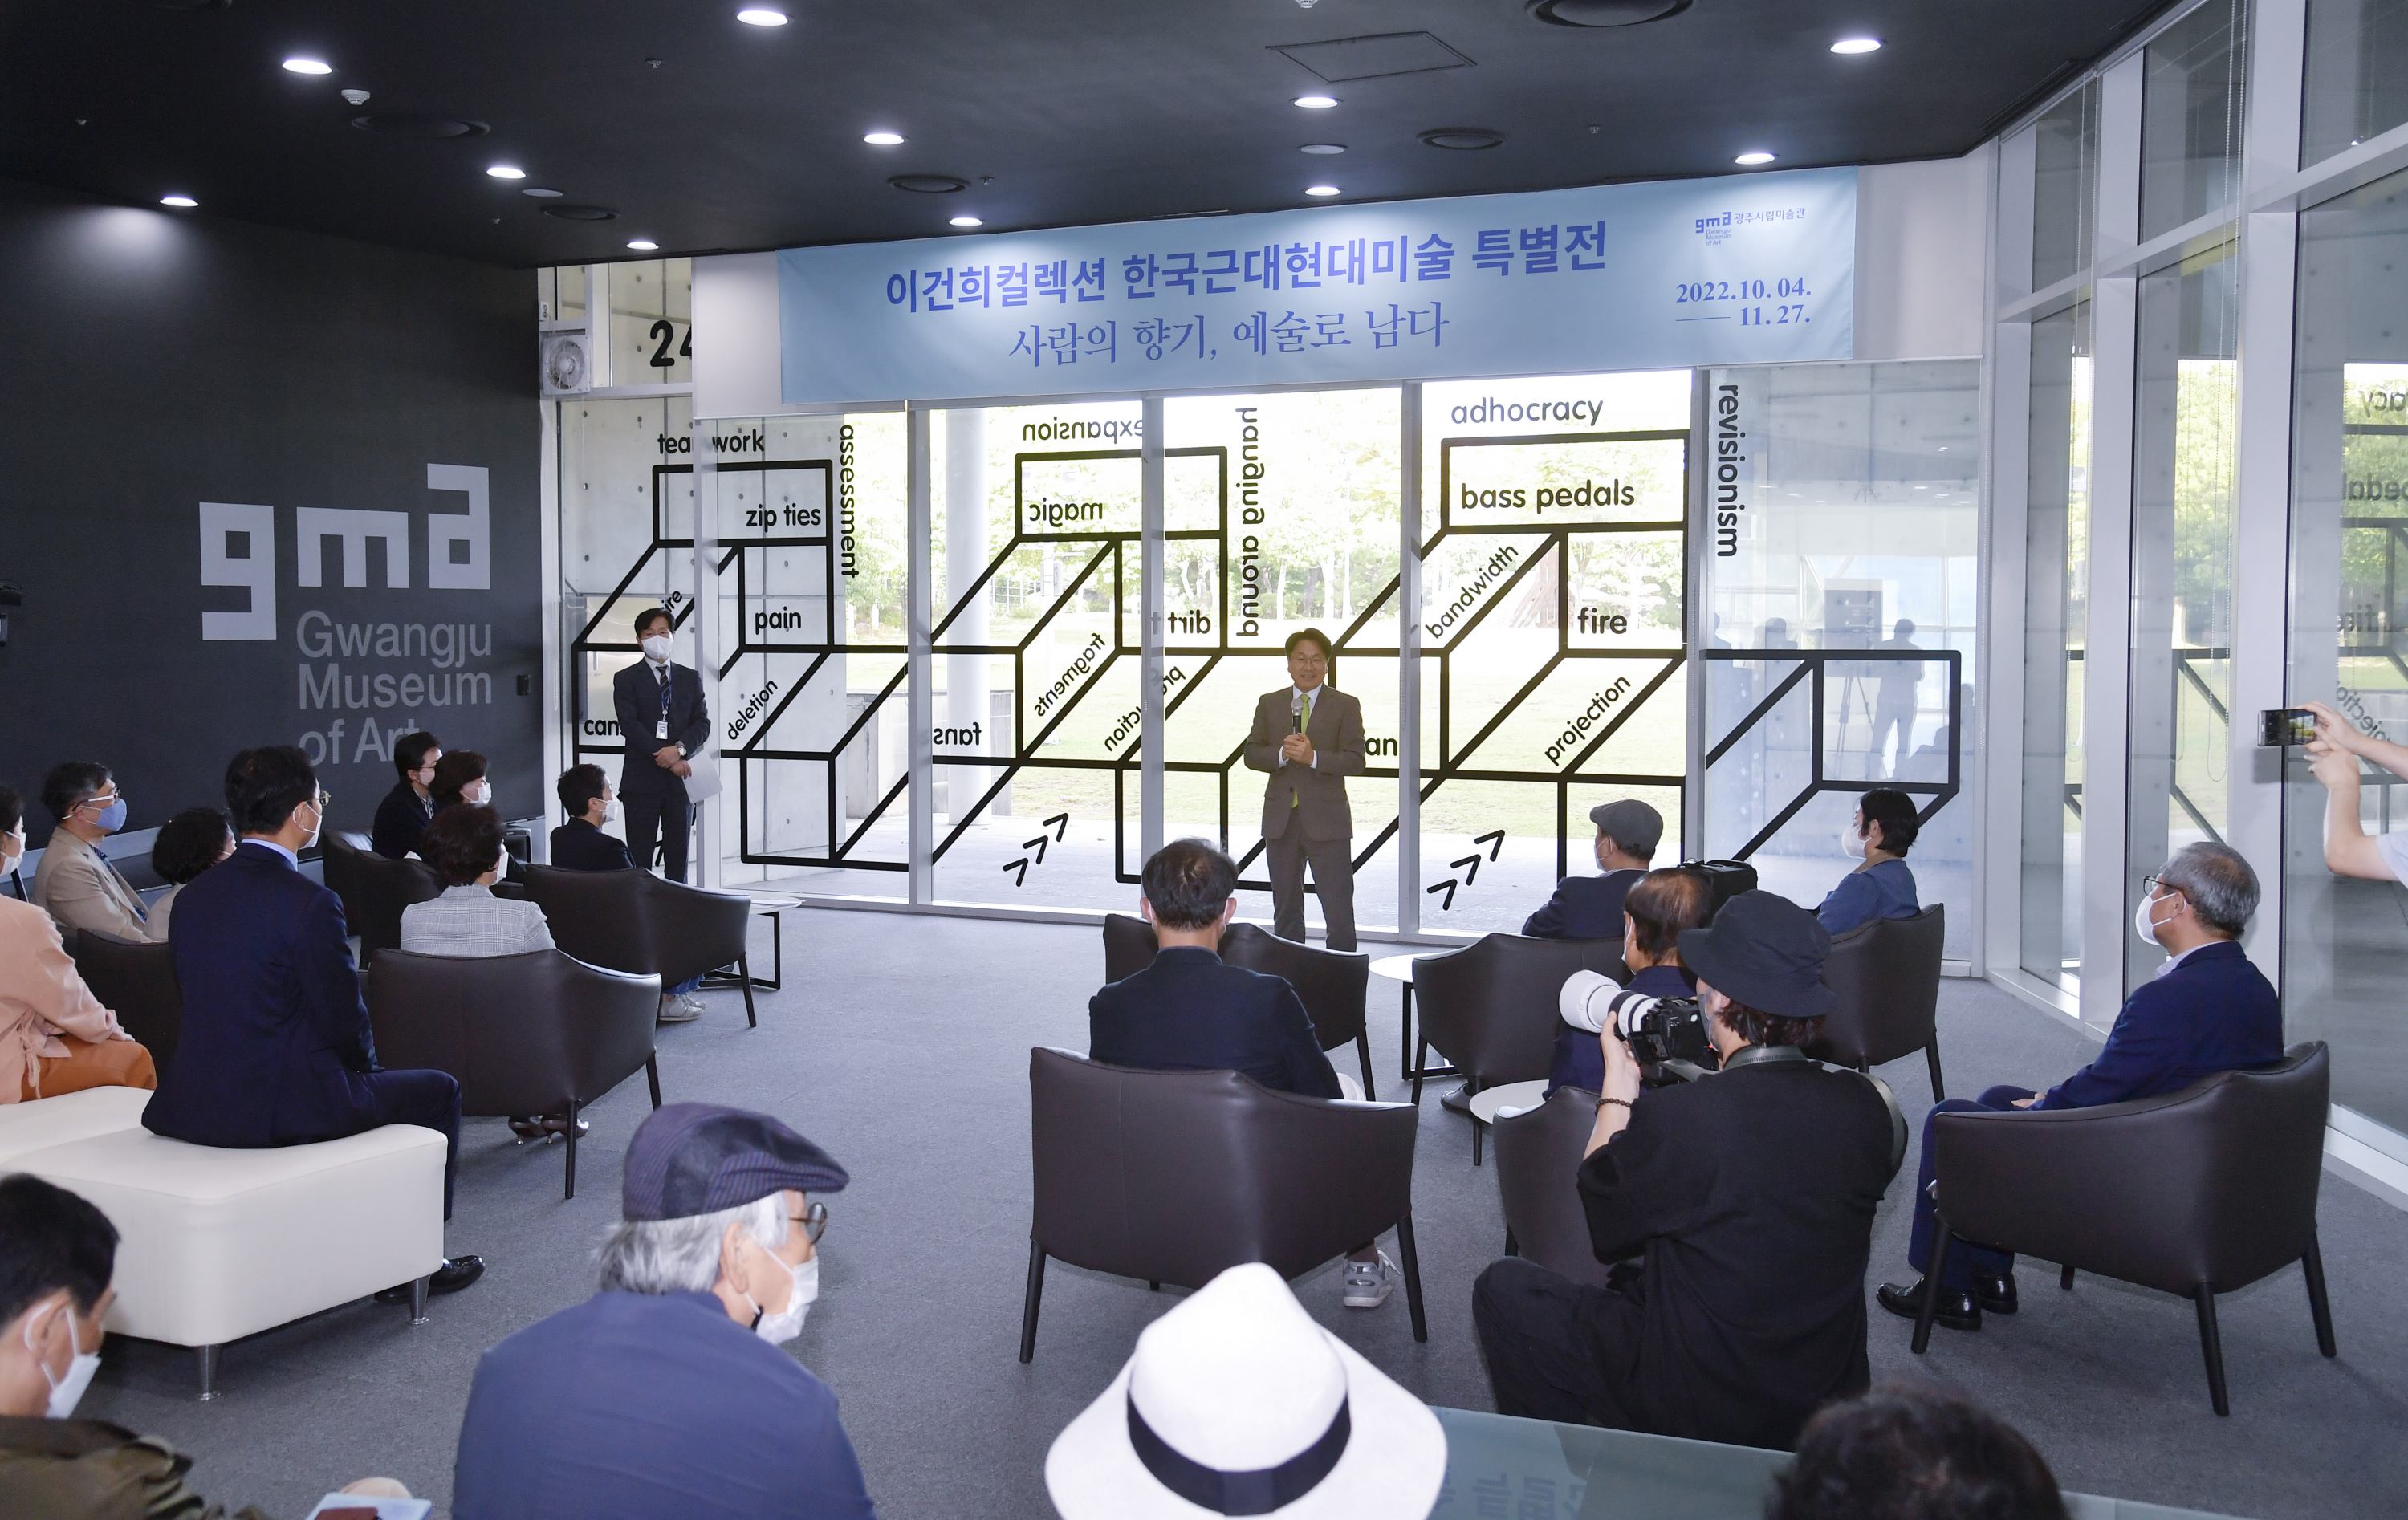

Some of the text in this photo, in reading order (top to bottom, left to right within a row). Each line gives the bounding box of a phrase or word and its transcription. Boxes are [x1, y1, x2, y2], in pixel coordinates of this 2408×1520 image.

[1695, 212, 1731, 234] gma
[1734, 207, 1806, 225] 광주시립미술관
[886, 220, 1606, 313] 이건희컬렉션 한국근대현대미술 특별전
[1008, 301, 1450, 368] 사람의 향기, 예술로 남다
[1450, 396, 1604, 426] adhocracy
[657, 428, 765, 455] teawork
[1716, 384, 1746, 557] revisionism
[746, 503, 822, 533] zip ties
[840, 424, 860, 579] assessment
[1461, 478, 1635, 514] bass pedals
[199, 463, 490, 640] gma
[1424, 543, 1519, 640] bandwidth
[296, 609, 492, 668] Gwangju
[755, 606, 802, 635] pain
[1577, 607, 1628, 636] fire
[298, 663, 492, 710] Museum
[727, 680, 779, 741] deletion
[1544, 675, 1631, 766] projection
[298, 718, 345, 766] of
[1364, 737, 1398, 756] an
